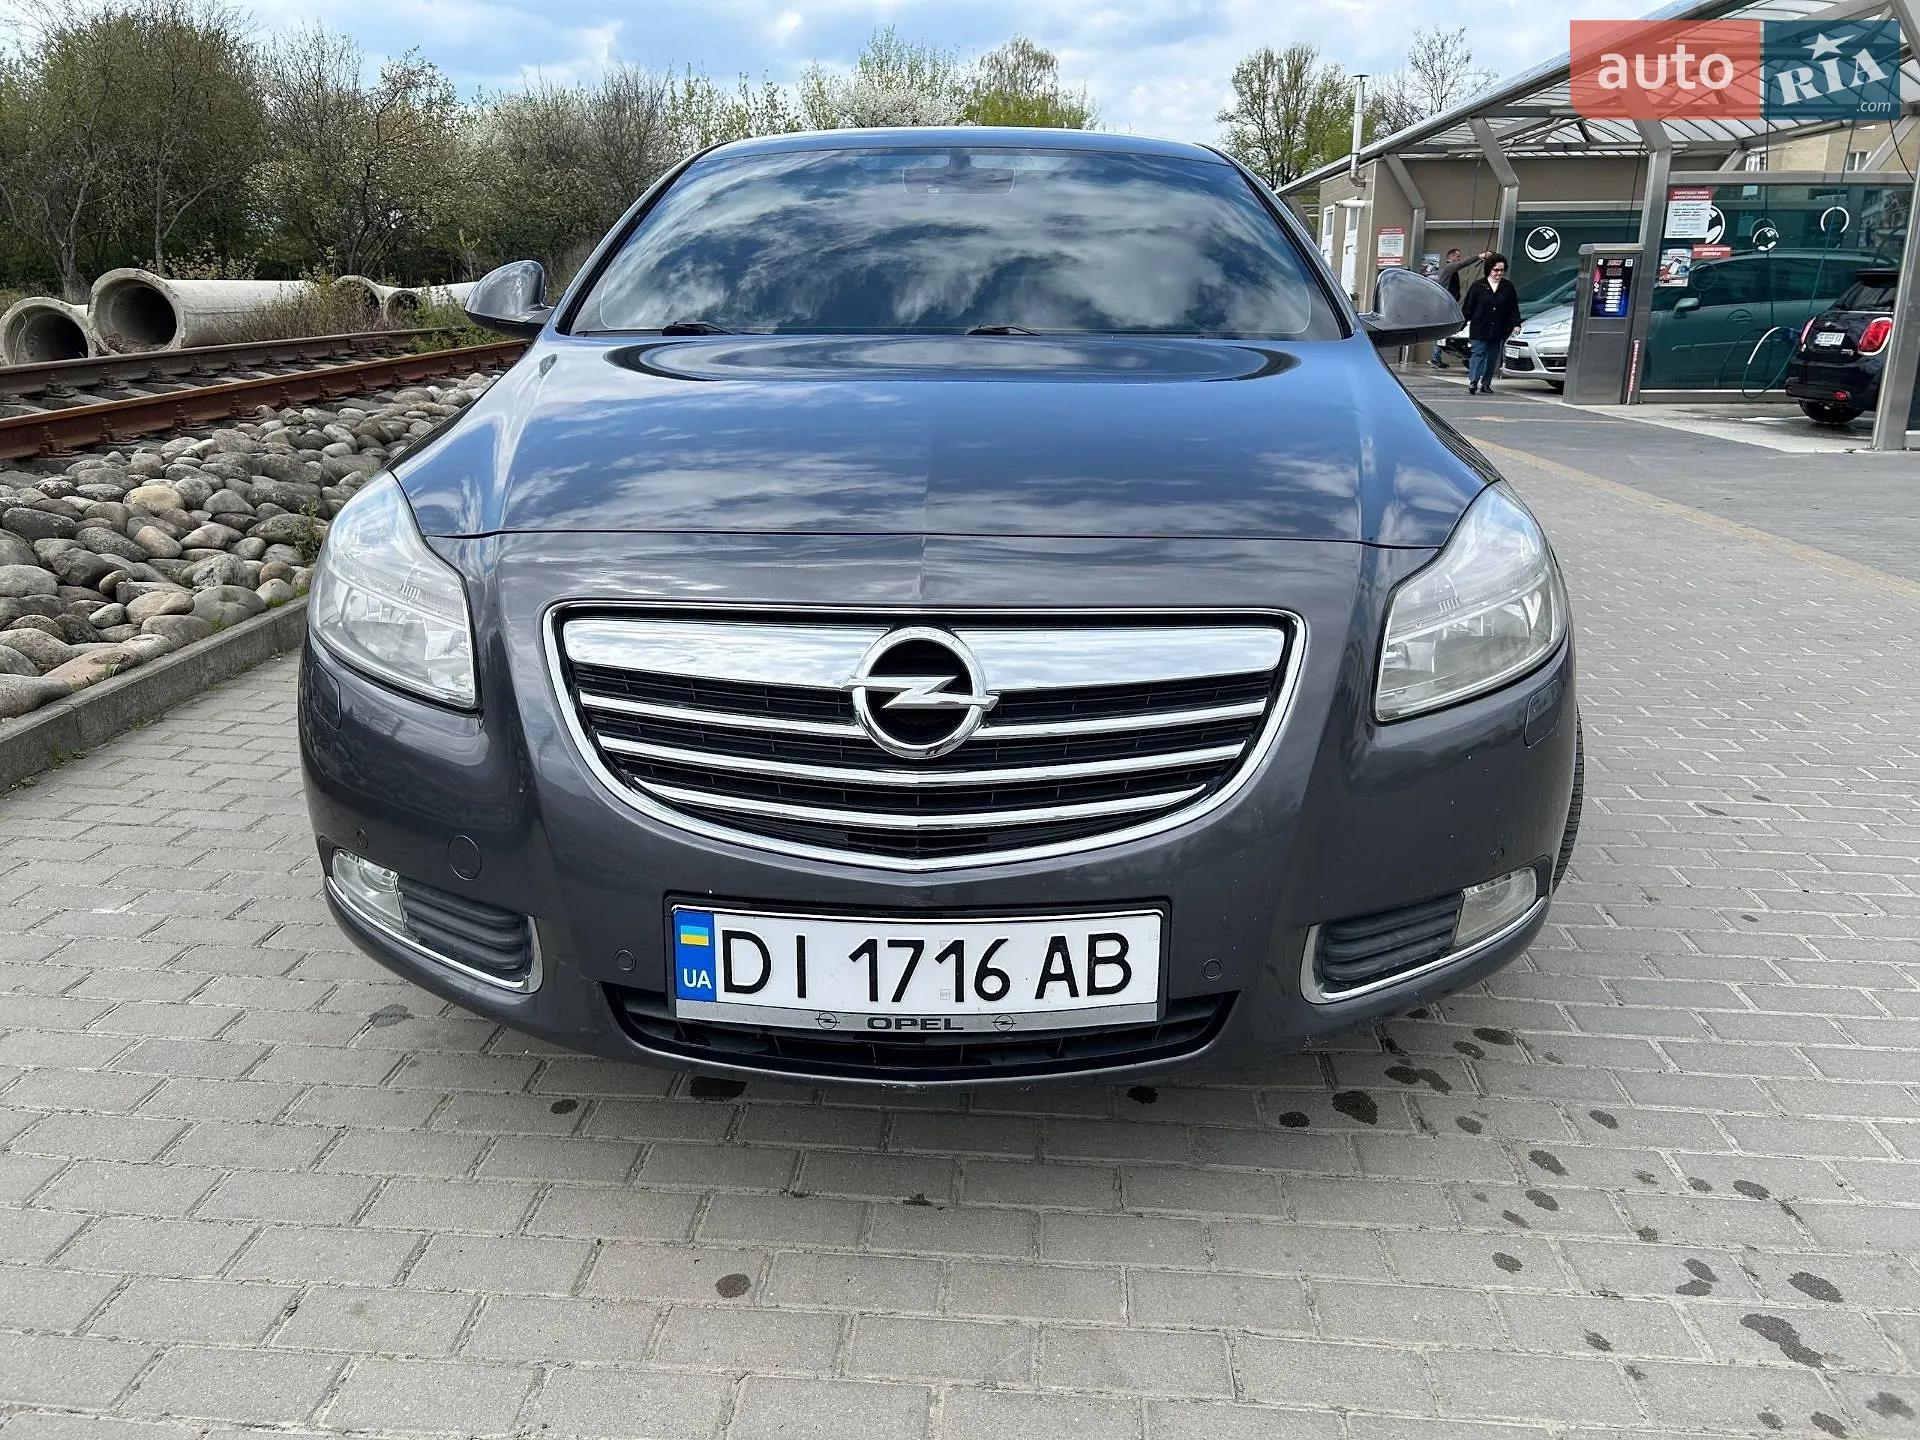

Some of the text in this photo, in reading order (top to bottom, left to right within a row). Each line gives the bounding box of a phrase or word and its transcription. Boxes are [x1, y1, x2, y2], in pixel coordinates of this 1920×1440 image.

[721, 929, 1132, 1003] DI 1716 AB
[683, 968, 713, 989] UA
[867, 1017, 964, 1031] OPEL
